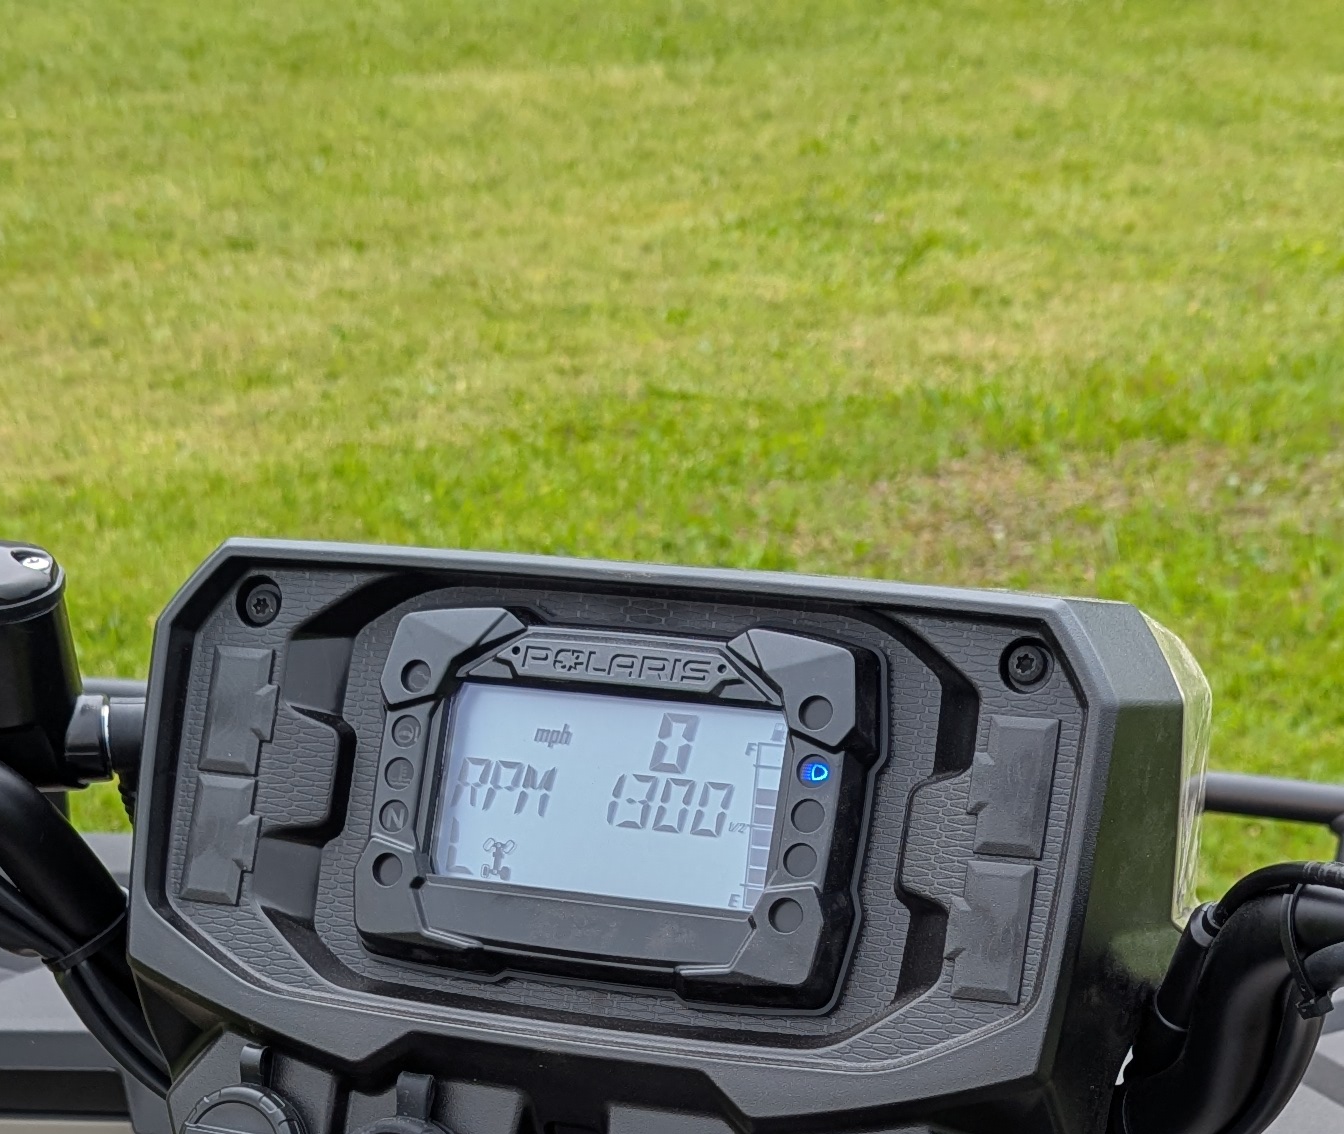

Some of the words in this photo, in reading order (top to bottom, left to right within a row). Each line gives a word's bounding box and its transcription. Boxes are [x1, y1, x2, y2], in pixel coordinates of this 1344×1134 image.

[521, 645, 711, 683] POLARIS
[534, 723, 573, 748] mph
[649, 712, 700, 774] 0
[451, 757, 558, 818] RPM
[607, 773, 735, 838] 1300
[385, 807, 405, 829] N
